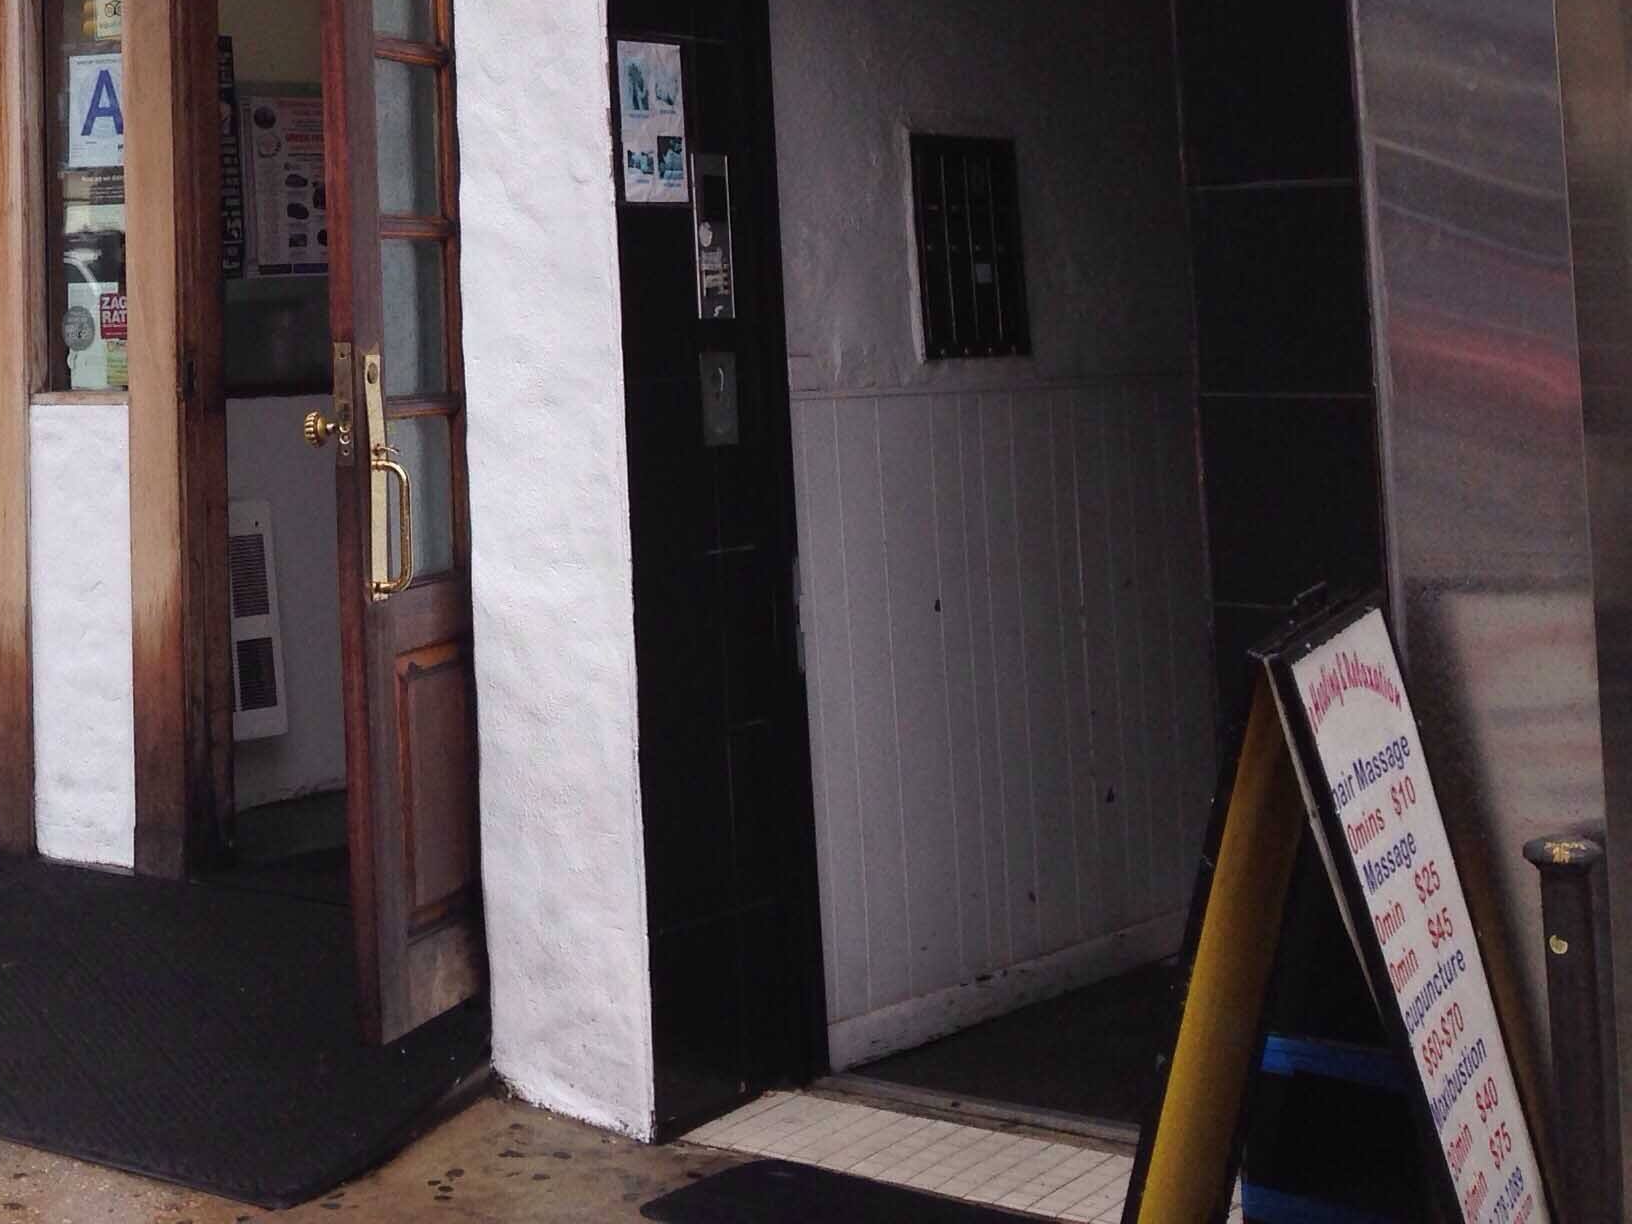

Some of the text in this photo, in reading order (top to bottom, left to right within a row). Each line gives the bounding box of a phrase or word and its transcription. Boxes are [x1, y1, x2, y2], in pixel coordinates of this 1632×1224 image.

[80, 69, 124, 136] A
[100, 295, 128, 310] ZAG
[101, 310, 128, 325] RAT
[1352, 735, 1411, 791] Massage
[1346, 775, 1417, 856] 0mins $10
[1362, 831, 1418, 896] Massage
[1374, 860, 1442, 945] 0min $25
[1389, 907, 1455, 994] 0min $45
[1403, 949, 1467, 1036] cupuncture
[1475, 1076, 1500, 1124] $40
[1488, 1121, 1512, 1170] $75
